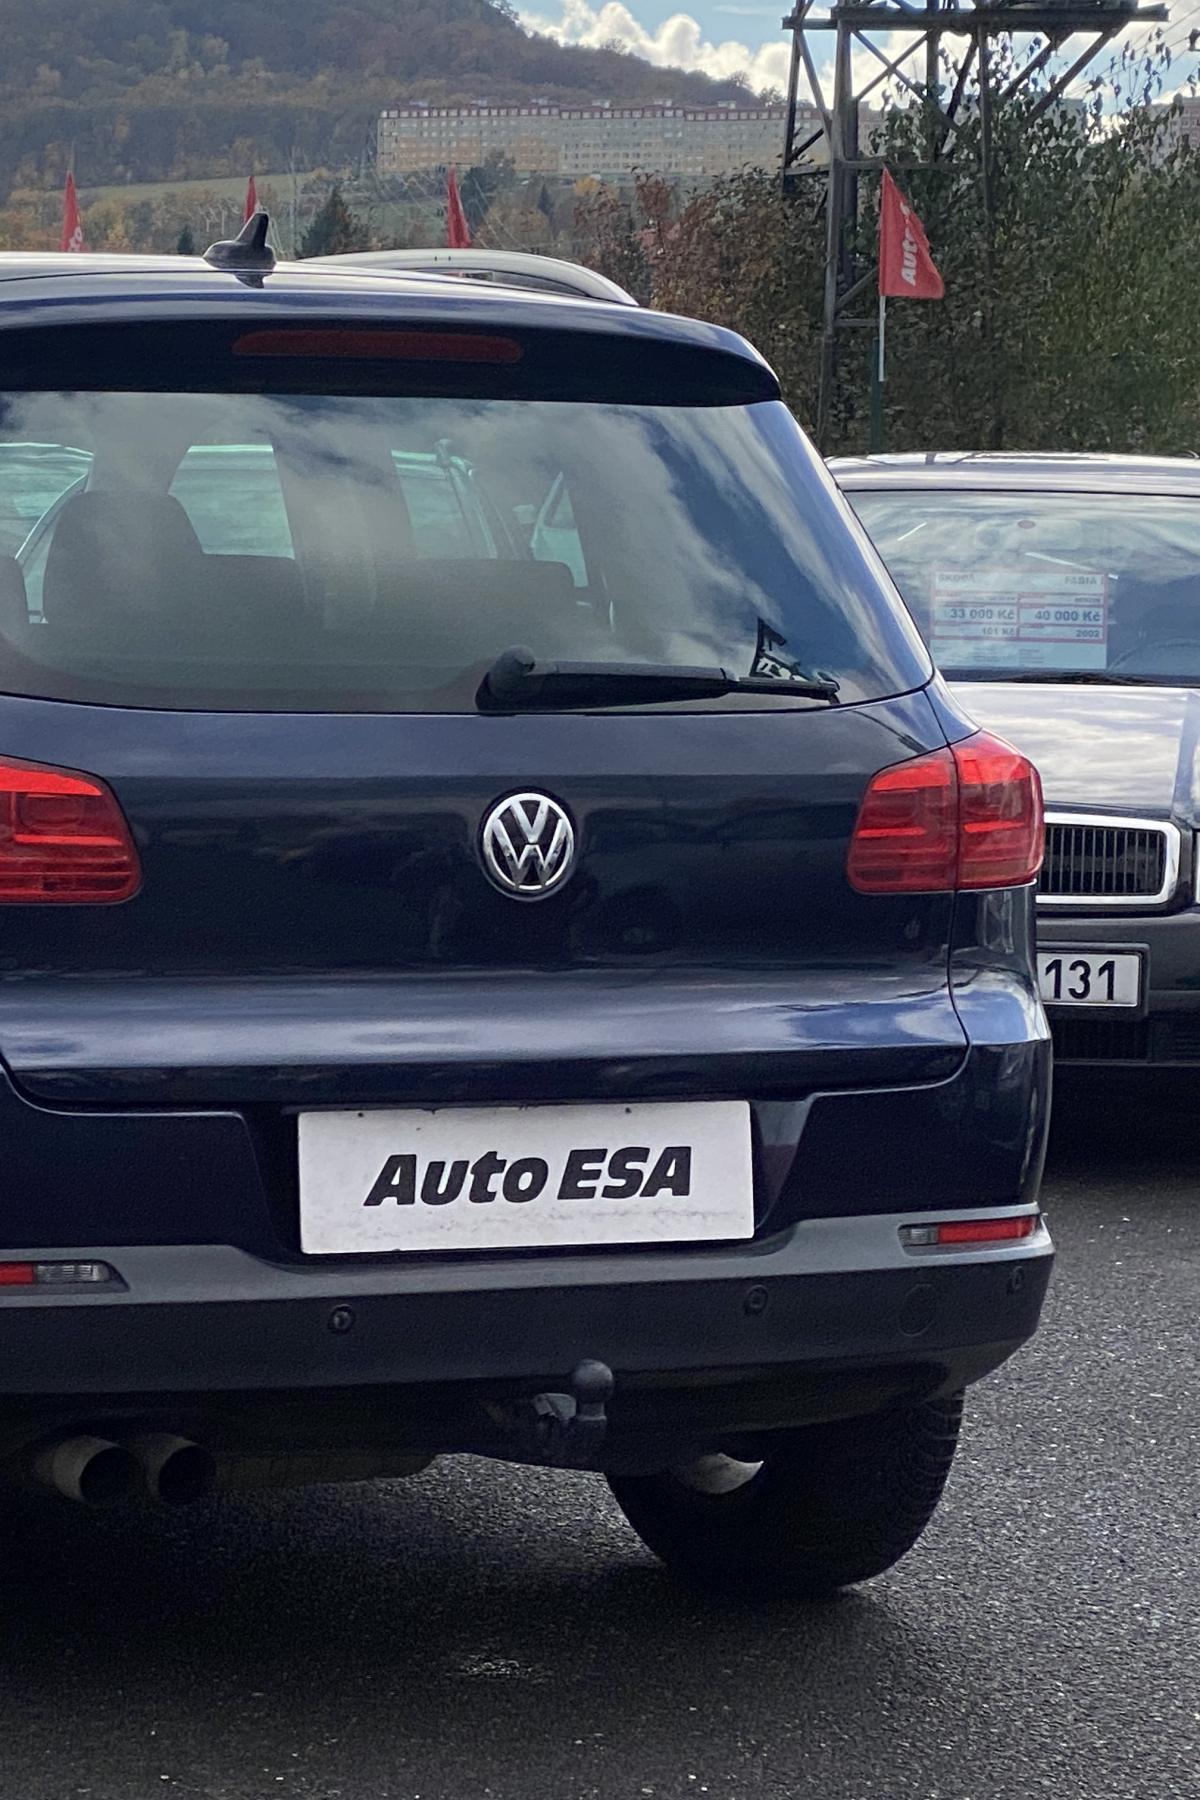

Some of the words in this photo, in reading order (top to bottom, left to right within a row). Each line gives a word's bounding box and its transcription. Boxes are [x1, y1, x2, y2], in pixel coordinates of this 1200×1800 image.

[969, 608, 993, 619] 000
[1034, 610, 1050, 621] 40
[1054, 610, 1079, 621] 000
[1082, 610, 1101, 622] Kč
[1045, 959, 1115, 1001] 131
[363, 1150, 550, 1206] Auto
[557, 1146, 692, 1201] ESA
